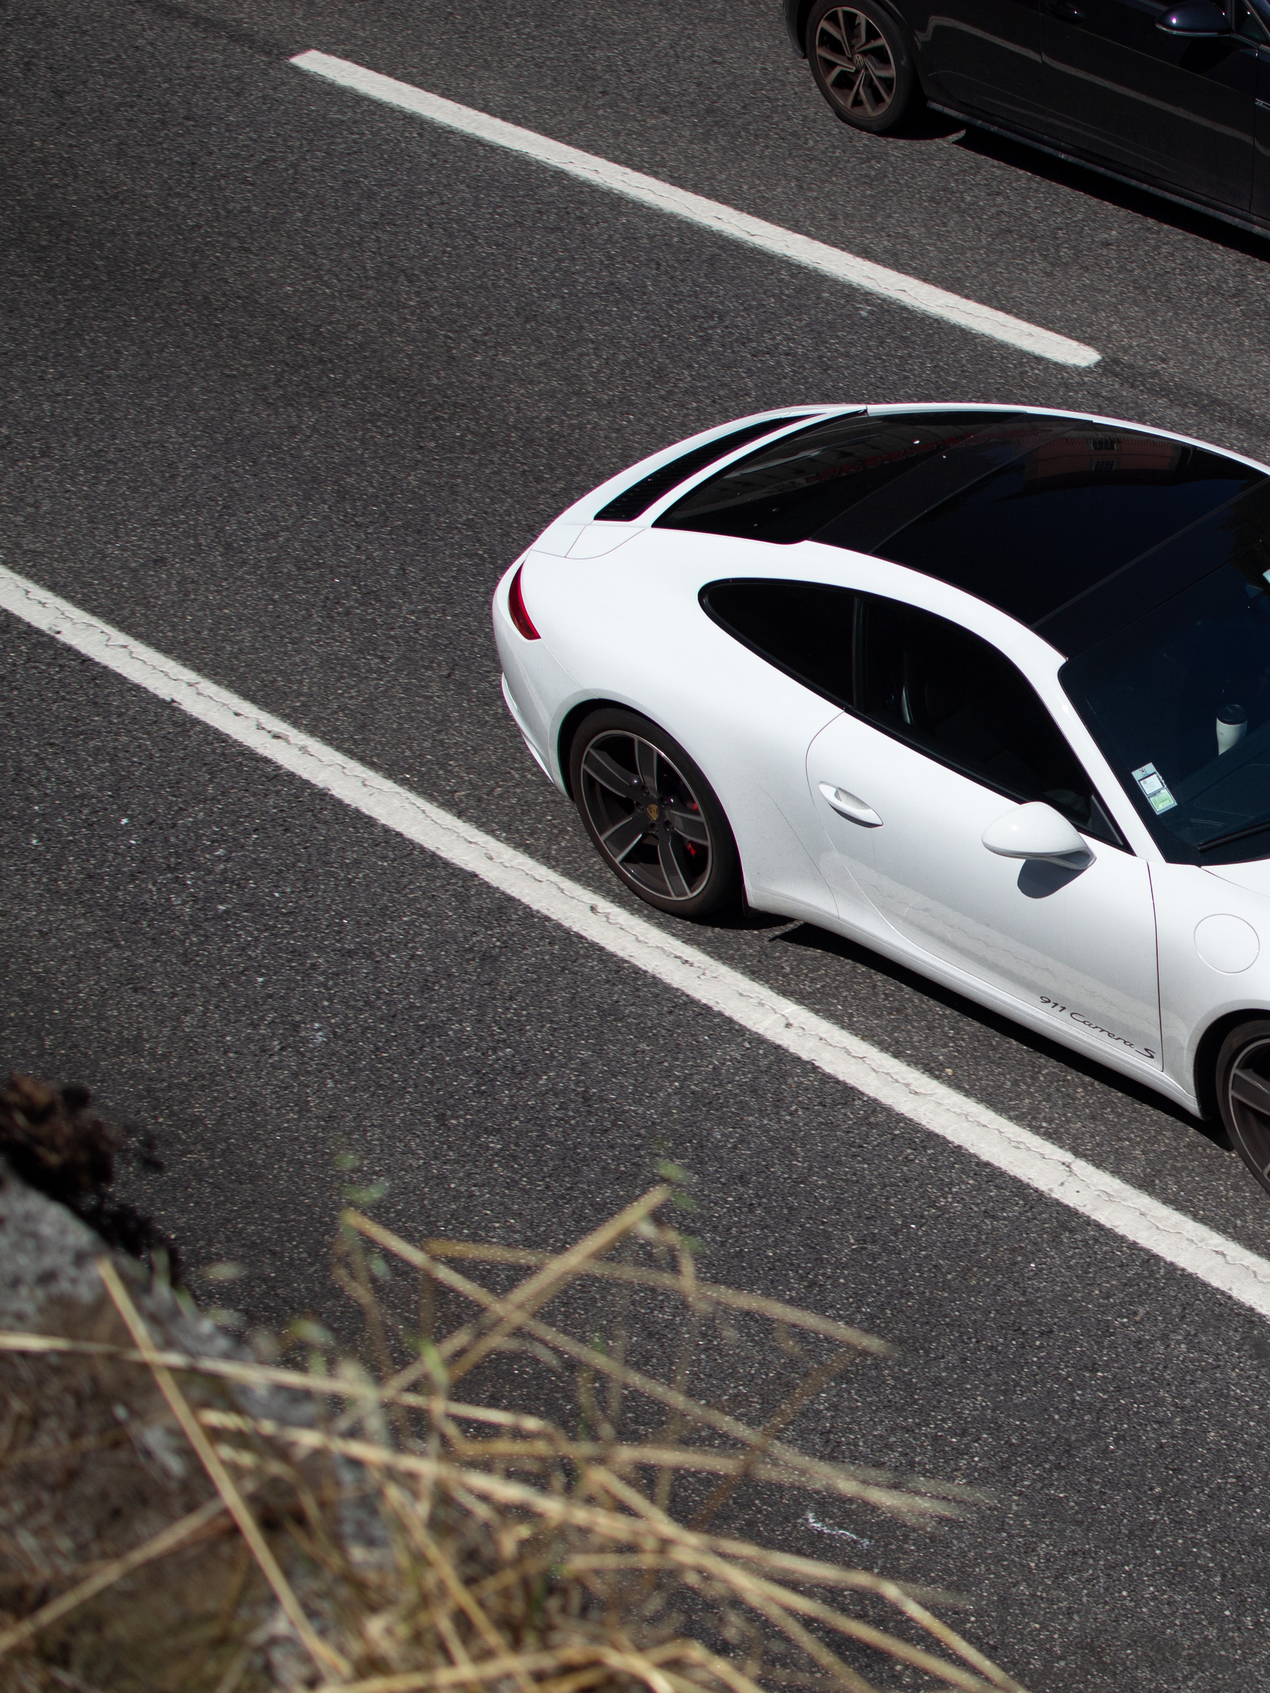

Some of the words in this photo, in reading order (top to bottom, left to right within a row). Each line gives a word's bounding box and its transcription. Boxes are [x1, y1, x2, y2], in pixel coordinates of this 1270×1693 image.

[1040, 995, 1067, 1013] 911
[1070, 1012, 1135, 1049] Carrera
[1135, 1047, 1156, 1059] S
